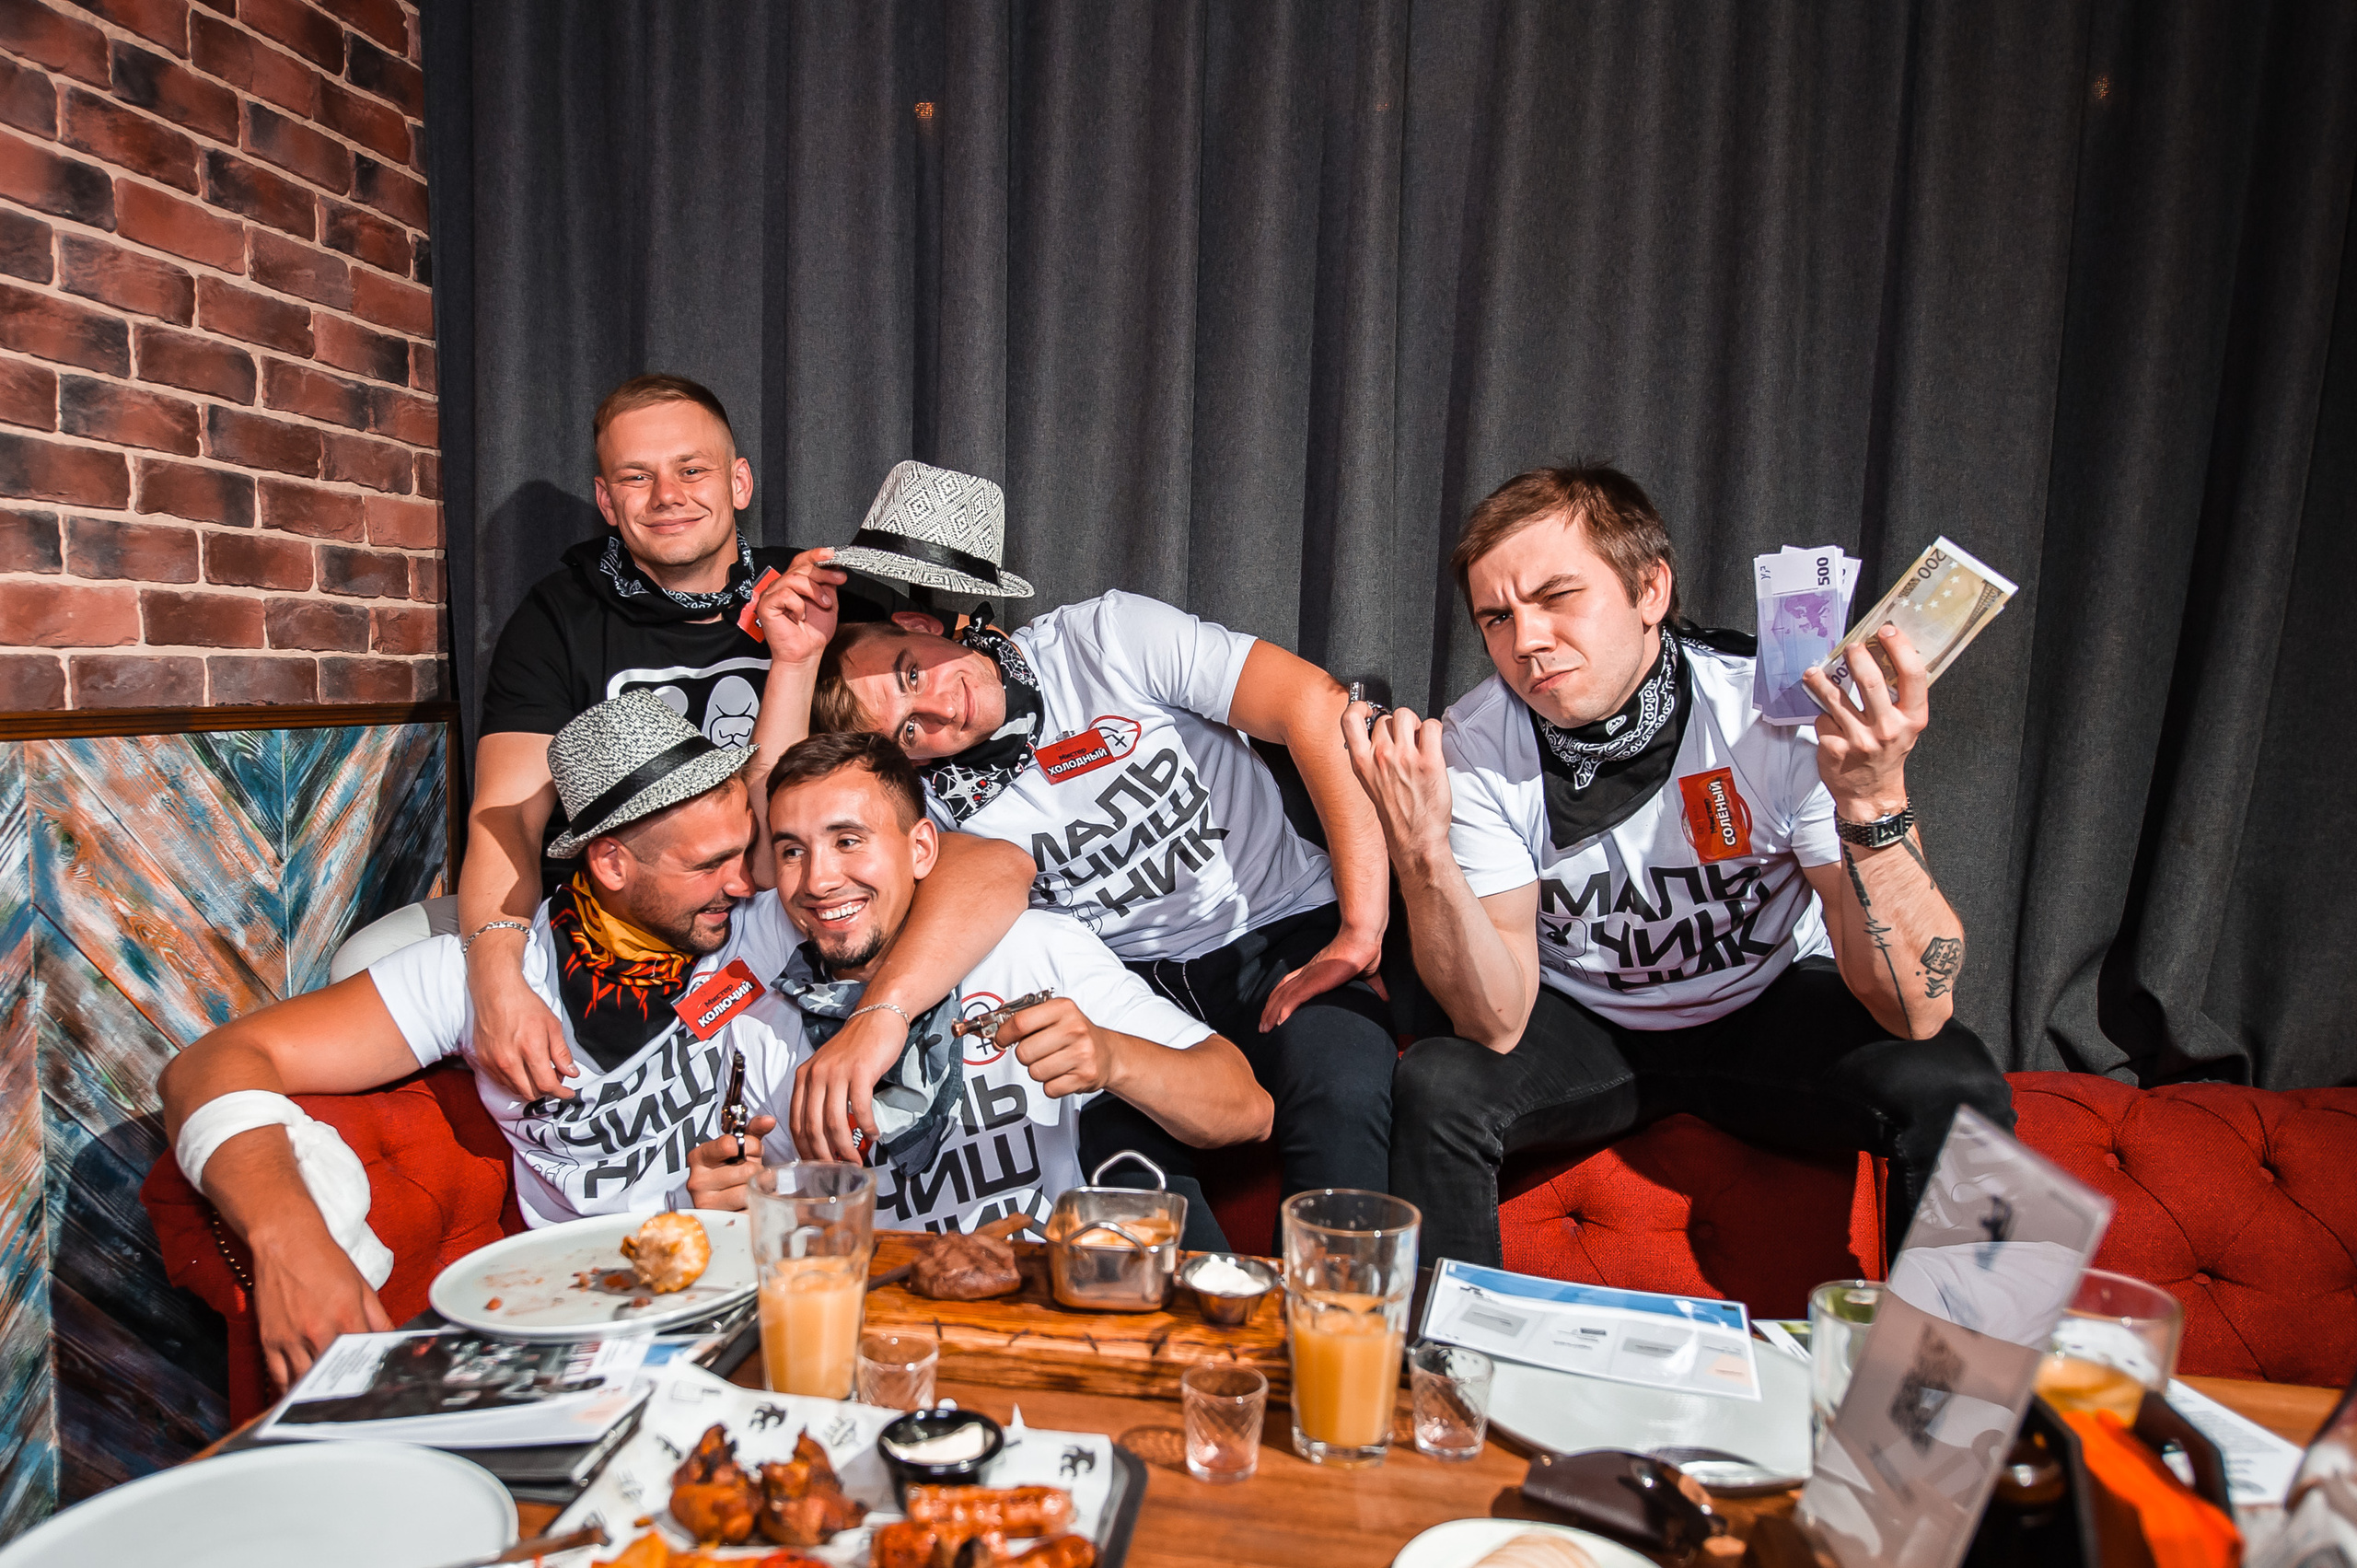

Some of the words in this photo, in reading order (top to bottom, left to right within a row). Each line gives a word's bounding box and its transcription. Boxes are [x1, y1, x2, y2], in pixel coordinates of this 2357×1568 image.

[1817, 556, 1830, 586] 500
[1917, 548, 1947, 579] 200
[1830, 660, 1849, 685] 00
[1047, 746, 1108, 776] ХОЛОДНЫЙ
[1058, 748, 1086, 761] Мистер
[1059, 766, 1210, 888] ЧИШ
[1707, 780, 1736, 846] СОЛЁНЫЙ
[1095, 803, 1231, 919] НИК
[1540, 864, 1762, 923] МАЛЬ
[697, 980, 754, 1028] КОЛЮЧИЙ
[703, 983, 734, 1008] Мистер
[558, 1046, 724, 1156] ЧИШ
